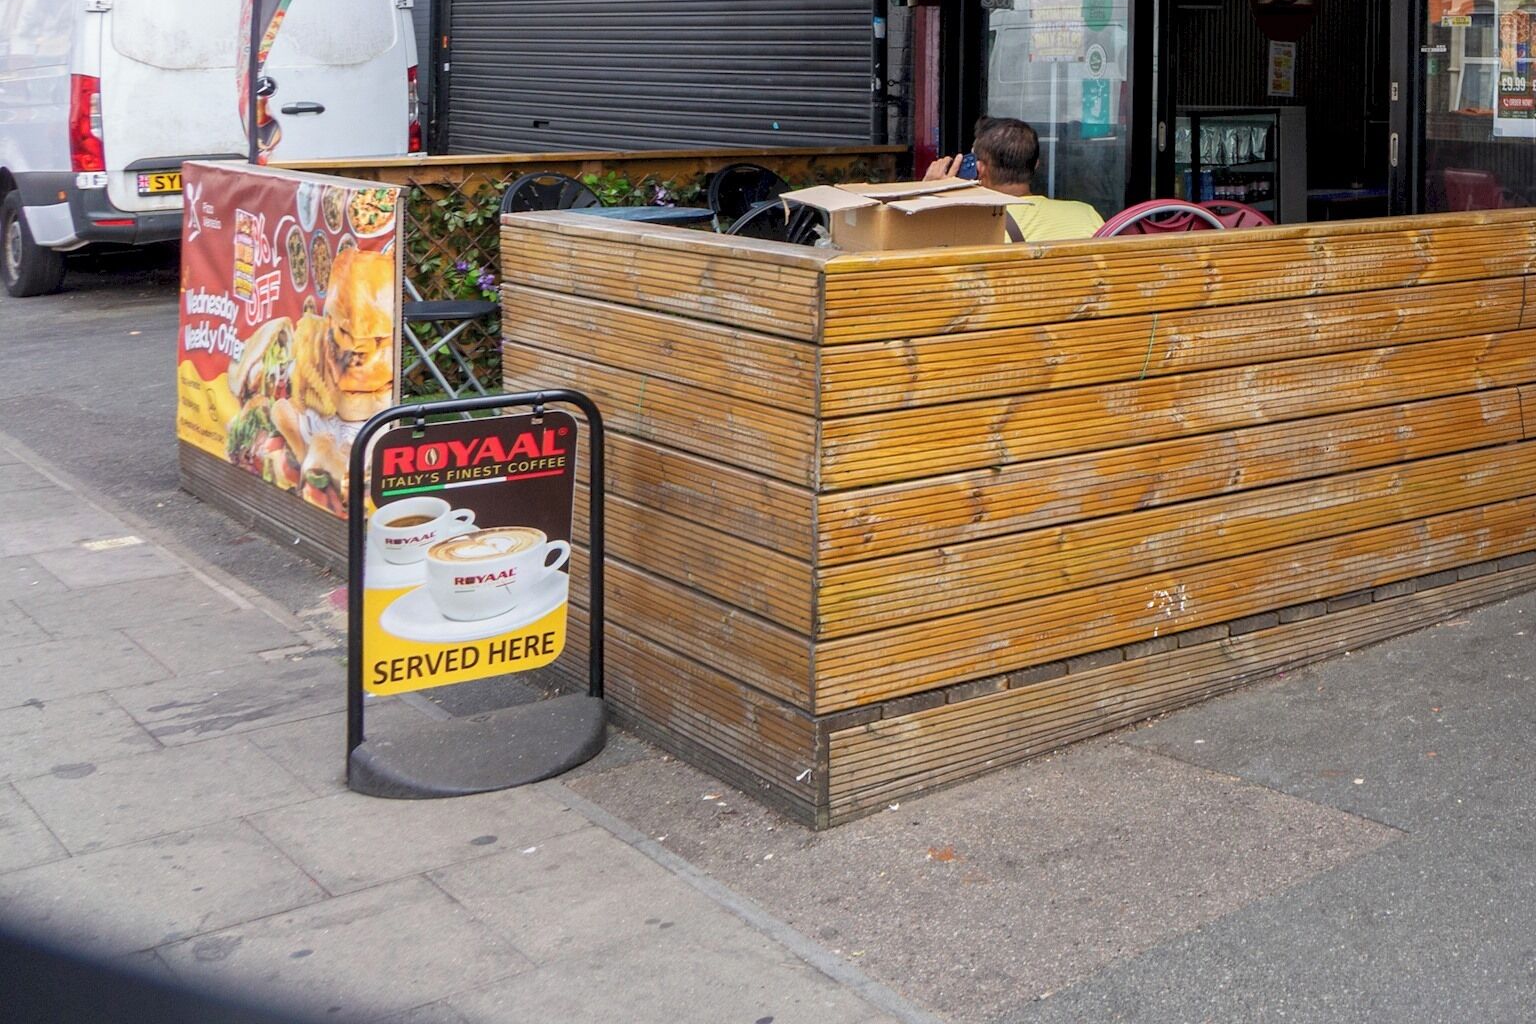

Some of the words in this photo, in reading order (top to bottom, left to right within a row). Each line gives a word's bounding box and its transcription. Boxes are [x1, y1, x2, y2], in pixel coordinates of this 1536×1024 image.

[1501, 76, 1526, 92] £9.99
[185, 286, 240, 324] Wednesday
[245, 271, 281, 325] OFF
[184, 320, 218, 355] Weekly
[382, 427, 567, 476] ROYAAL
[381, 472, 440, 489] ITALY'S
[447, 464, 502, 481] FINEST
[507, 456, 567, 473] COFFEE
[384, 531, 436, 545] ROYAAL
[454, 567, 517, 586] ROYAAL
[373, 645, 481, 686] SERVED
[488, 630, 556, 666] HERE
